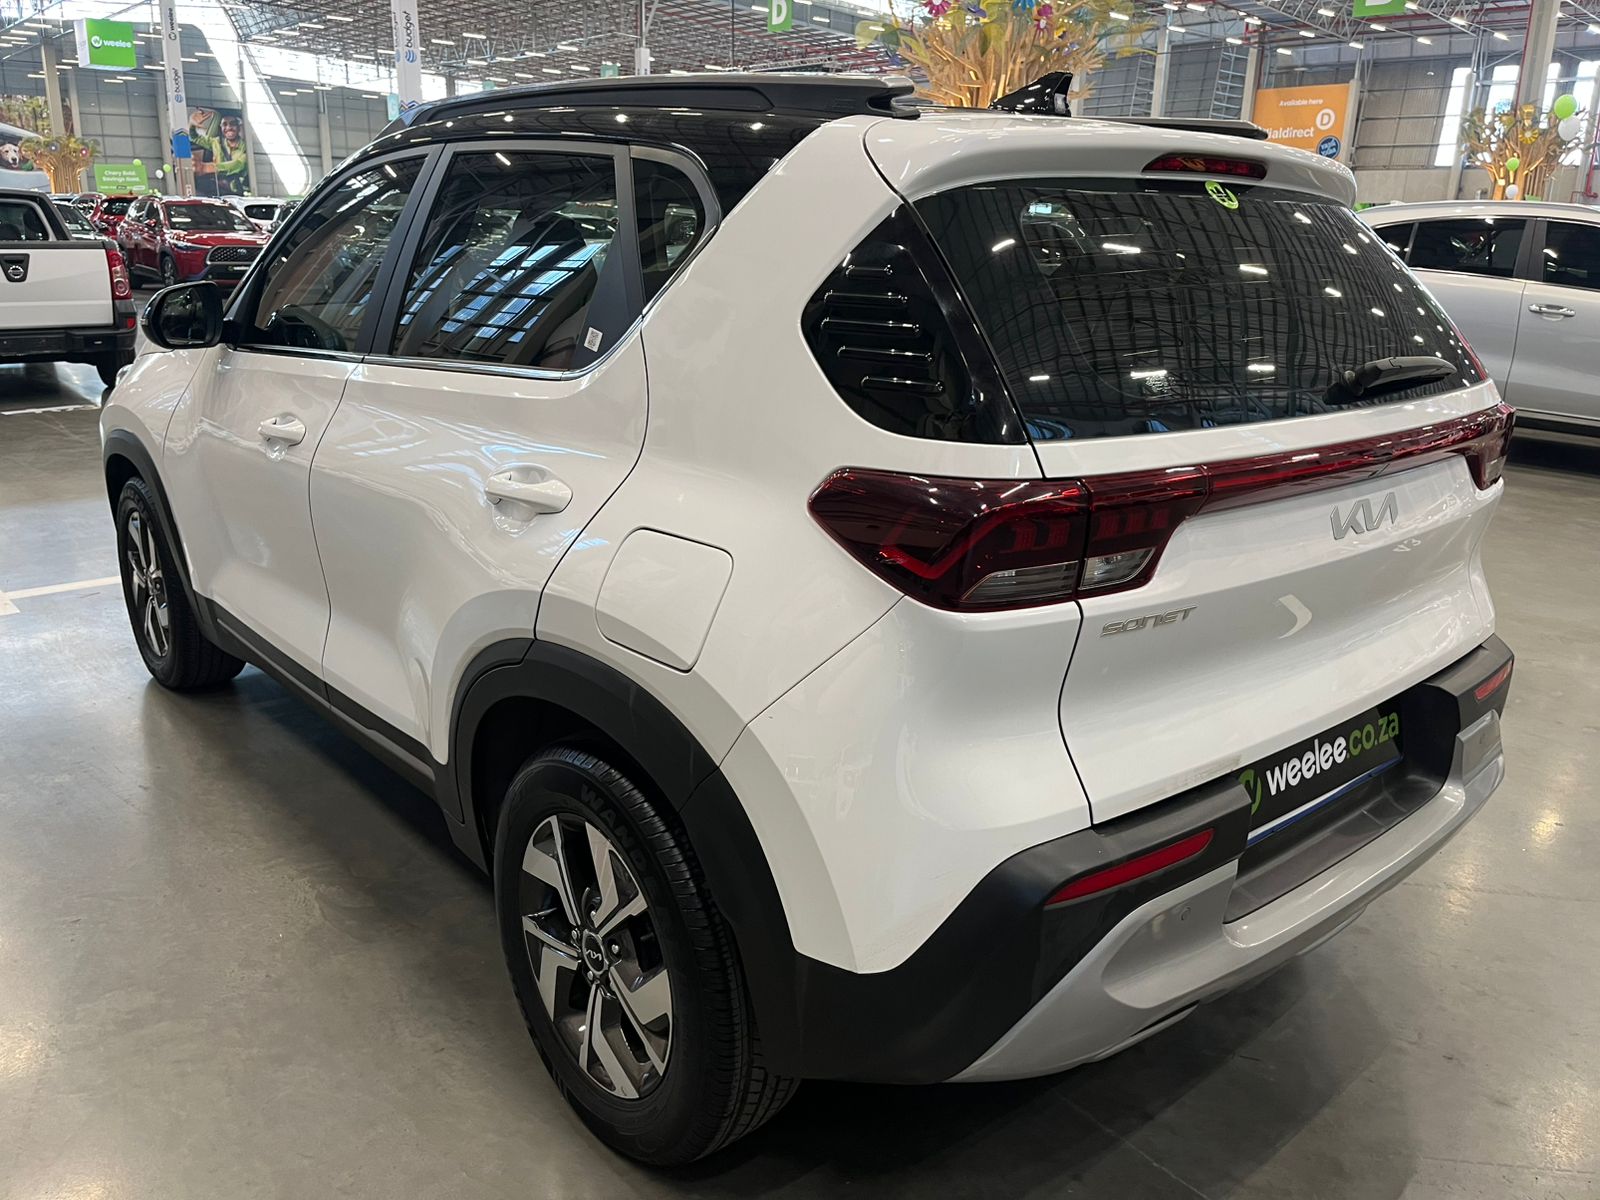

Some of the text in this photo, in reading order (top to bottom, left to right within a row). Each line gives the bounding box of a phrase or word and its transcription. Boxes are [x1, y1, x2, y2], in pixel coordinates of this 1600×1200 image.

[772, 0, 787, 25] D
[402, 10, 415, 48] budget
[103, 40, 132, 49] weelee
[172, 68, 181, 92] budget
[1100, 605, 1198, 638] SONET
[1265, 711, 1400, 796] weelee.co.za
